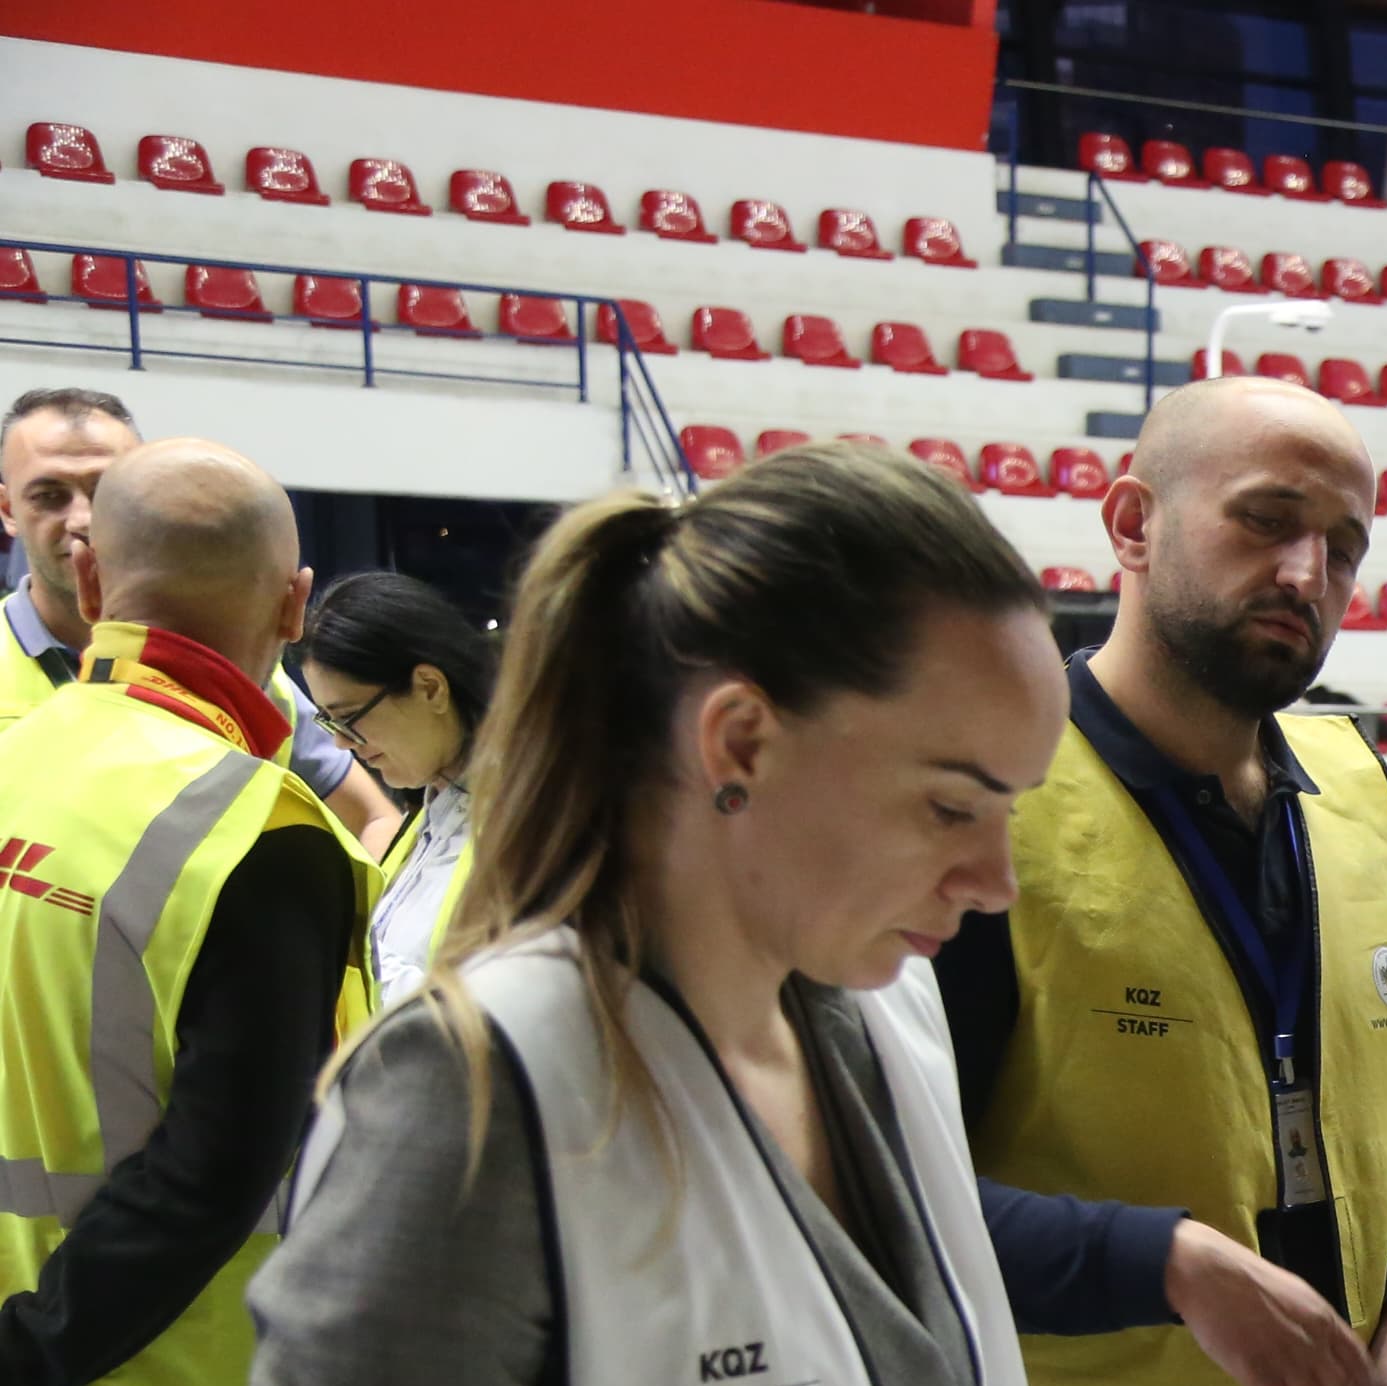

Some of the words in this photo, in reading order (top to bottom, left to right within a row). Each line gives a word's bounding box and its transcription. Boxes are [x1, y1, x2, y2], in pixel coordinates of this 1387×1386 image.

[1125, 987, 1162, 1007] KQZ
[1117, 1018, 1169, 1037] STAFF
[700, 1341, 769, 1383] KQZ
